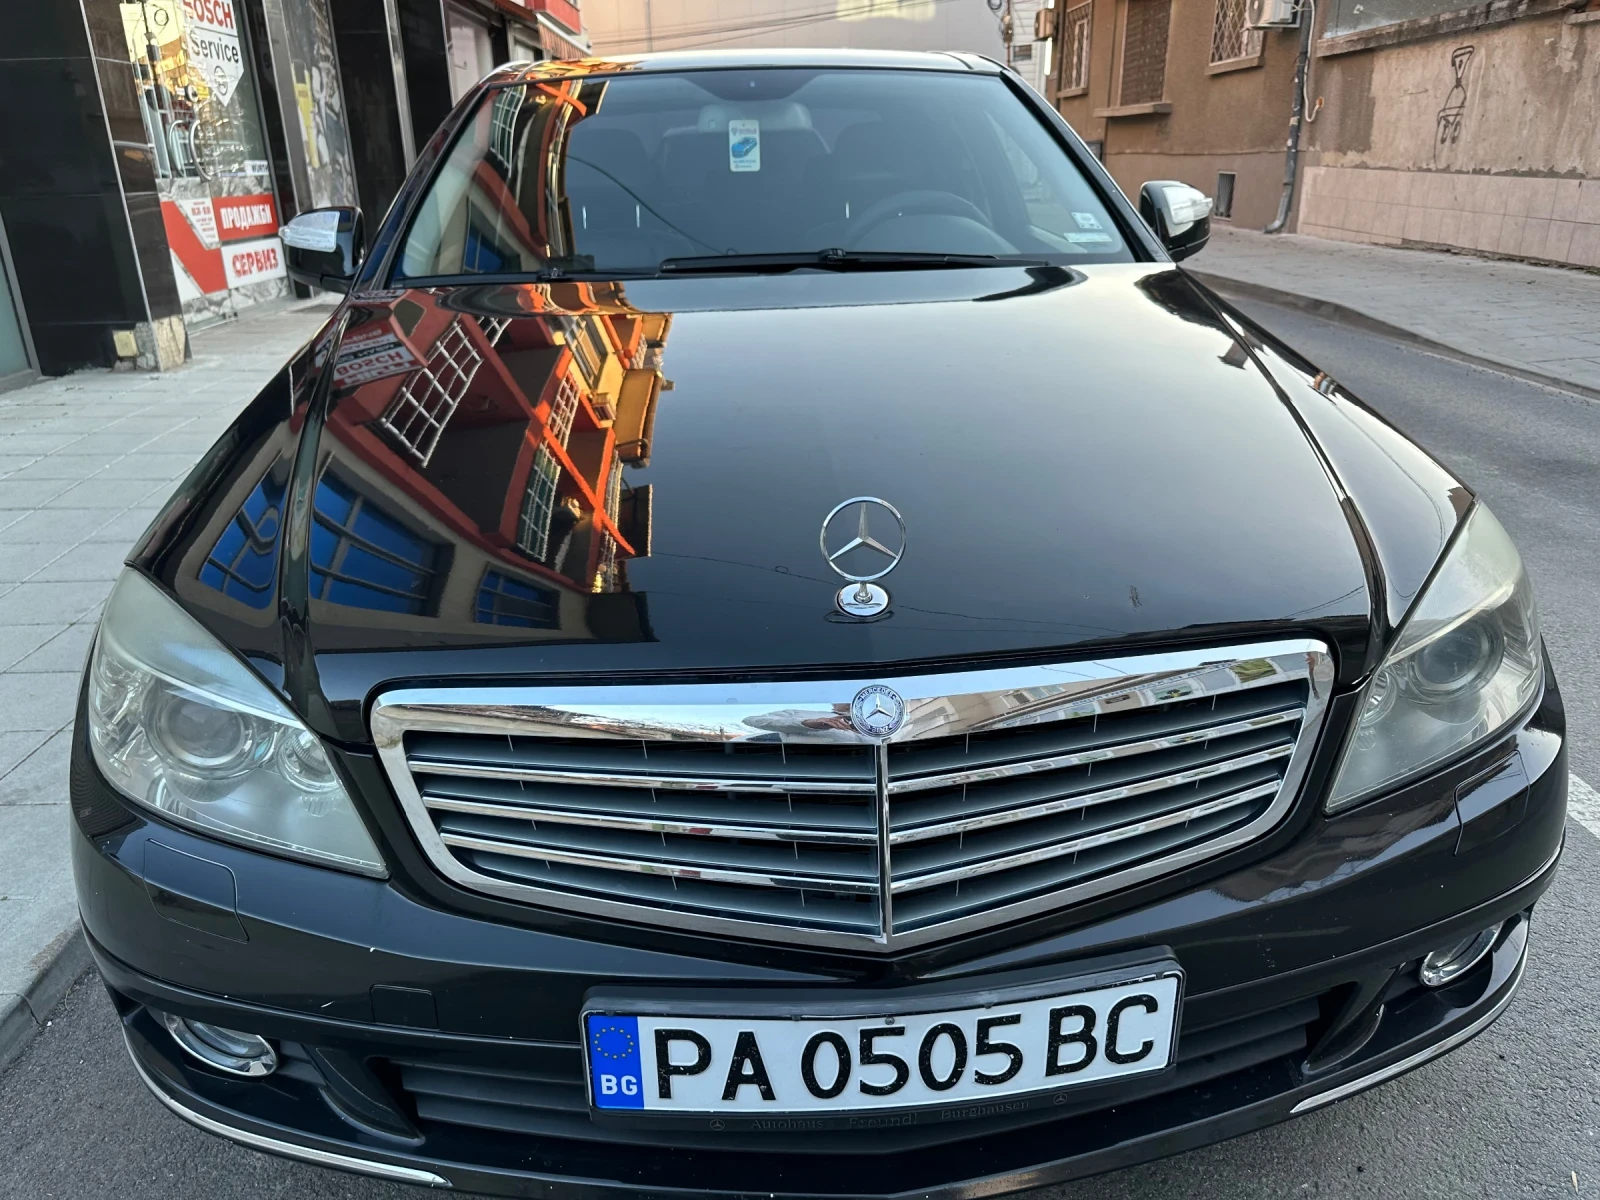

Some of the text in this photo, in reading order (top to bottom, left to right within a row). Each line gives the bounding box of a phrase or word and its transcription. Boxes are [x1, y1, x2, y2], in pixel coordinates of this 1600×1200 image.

[190, 30, 239, 64] Service
[233, 248, 279, 278] СЕРВИЗ
[653, 993, 1159, 1101] PA 0505 BC
[600, 1073, 638, 1097] BG
[751, 1118, 824, 1130] Autohaus
[940, 1100, 1030, 1120] Burghausen
